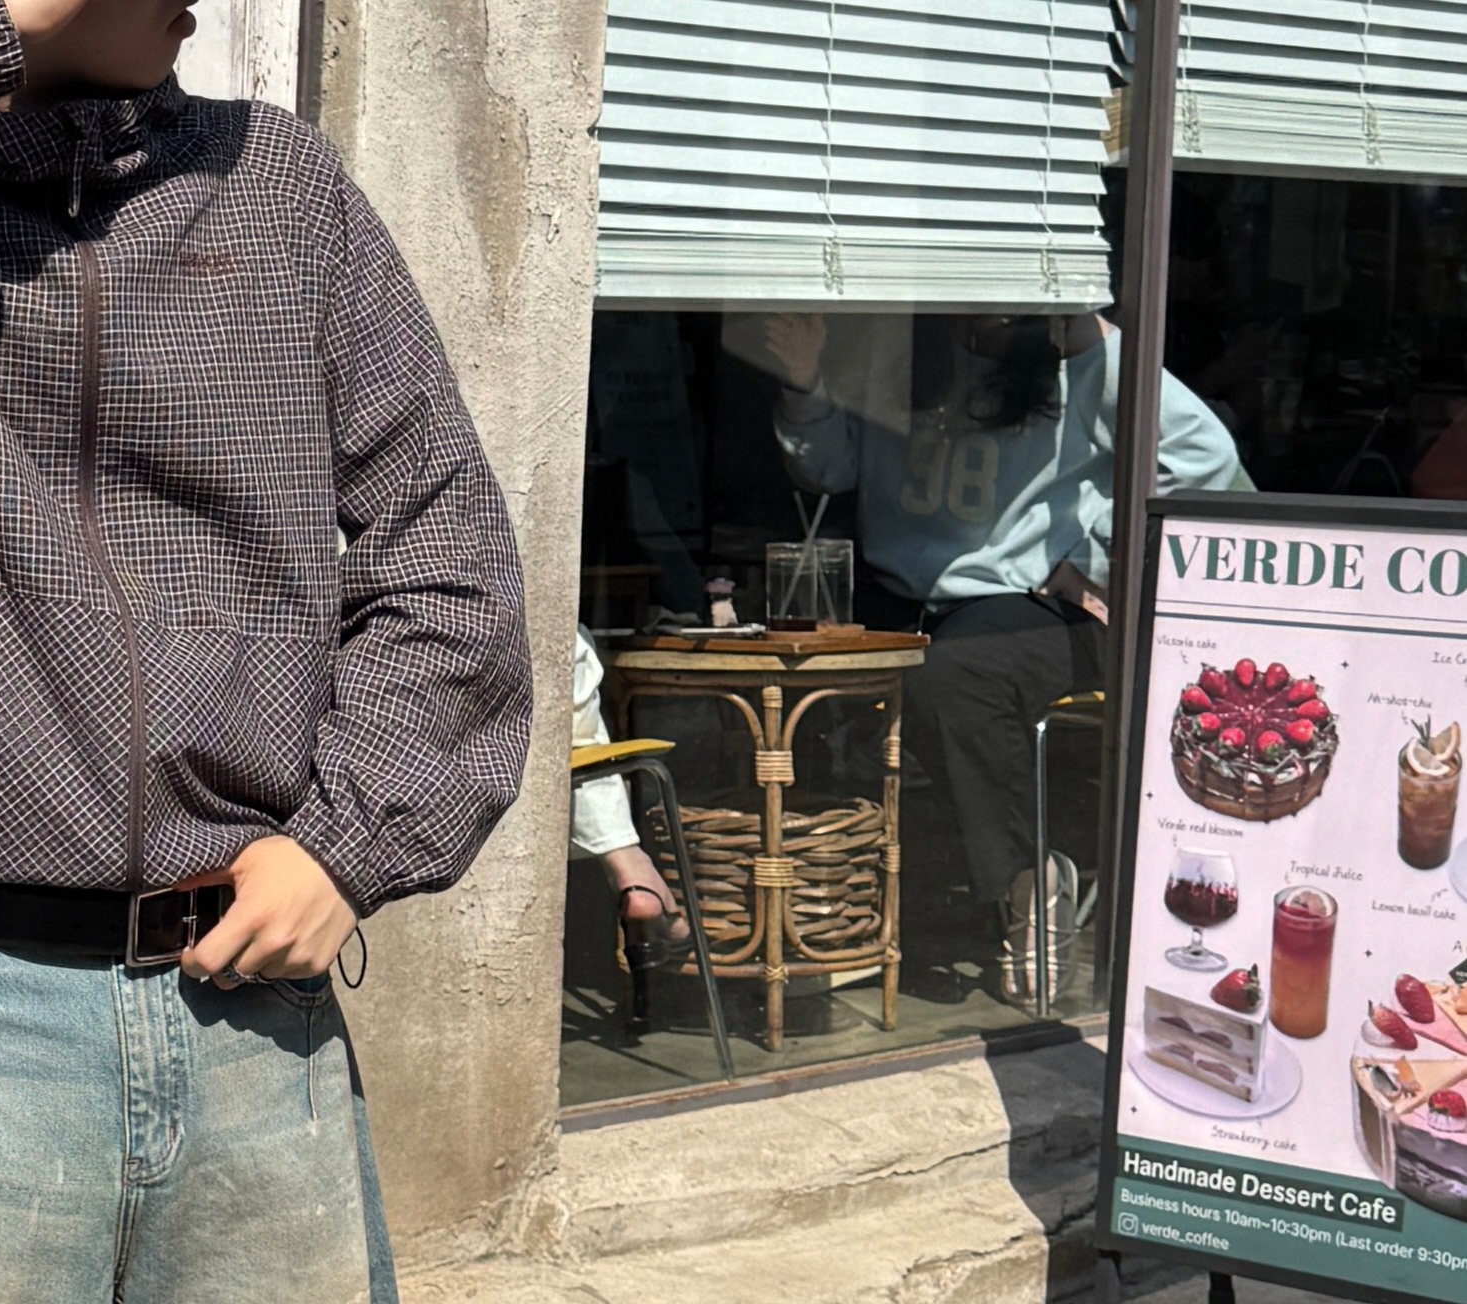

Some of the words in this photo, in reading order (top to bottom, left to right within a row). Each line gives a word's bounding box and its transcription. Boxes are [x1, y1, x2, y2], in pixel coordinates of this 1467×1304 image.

[1165, 534, 1364, 590] VERDE
[1189, 822, 1206, 834] red
[1290, 860, 1330, 878] Tropical
[1371, 899, 1405, 914] Lemon
[1433, 909, 1457, 921] cake
[1273, 1137, 1297, 1151] cake
[1123, 1151, 1236, 1193] Handmade
[1241, 1173, 1334, 1212] Dessert
[1340, 1193, 1396, 1223] Cafe
[1121, 1188, 1179, 1213] Business
[1182, 1201, 1221, 1222] hours
[1335, 1230, 1371, 1252] (Last
[1374, 1241, 1414, 1259] order
[1142, 1222, 1230, 1250] verde_coffee
